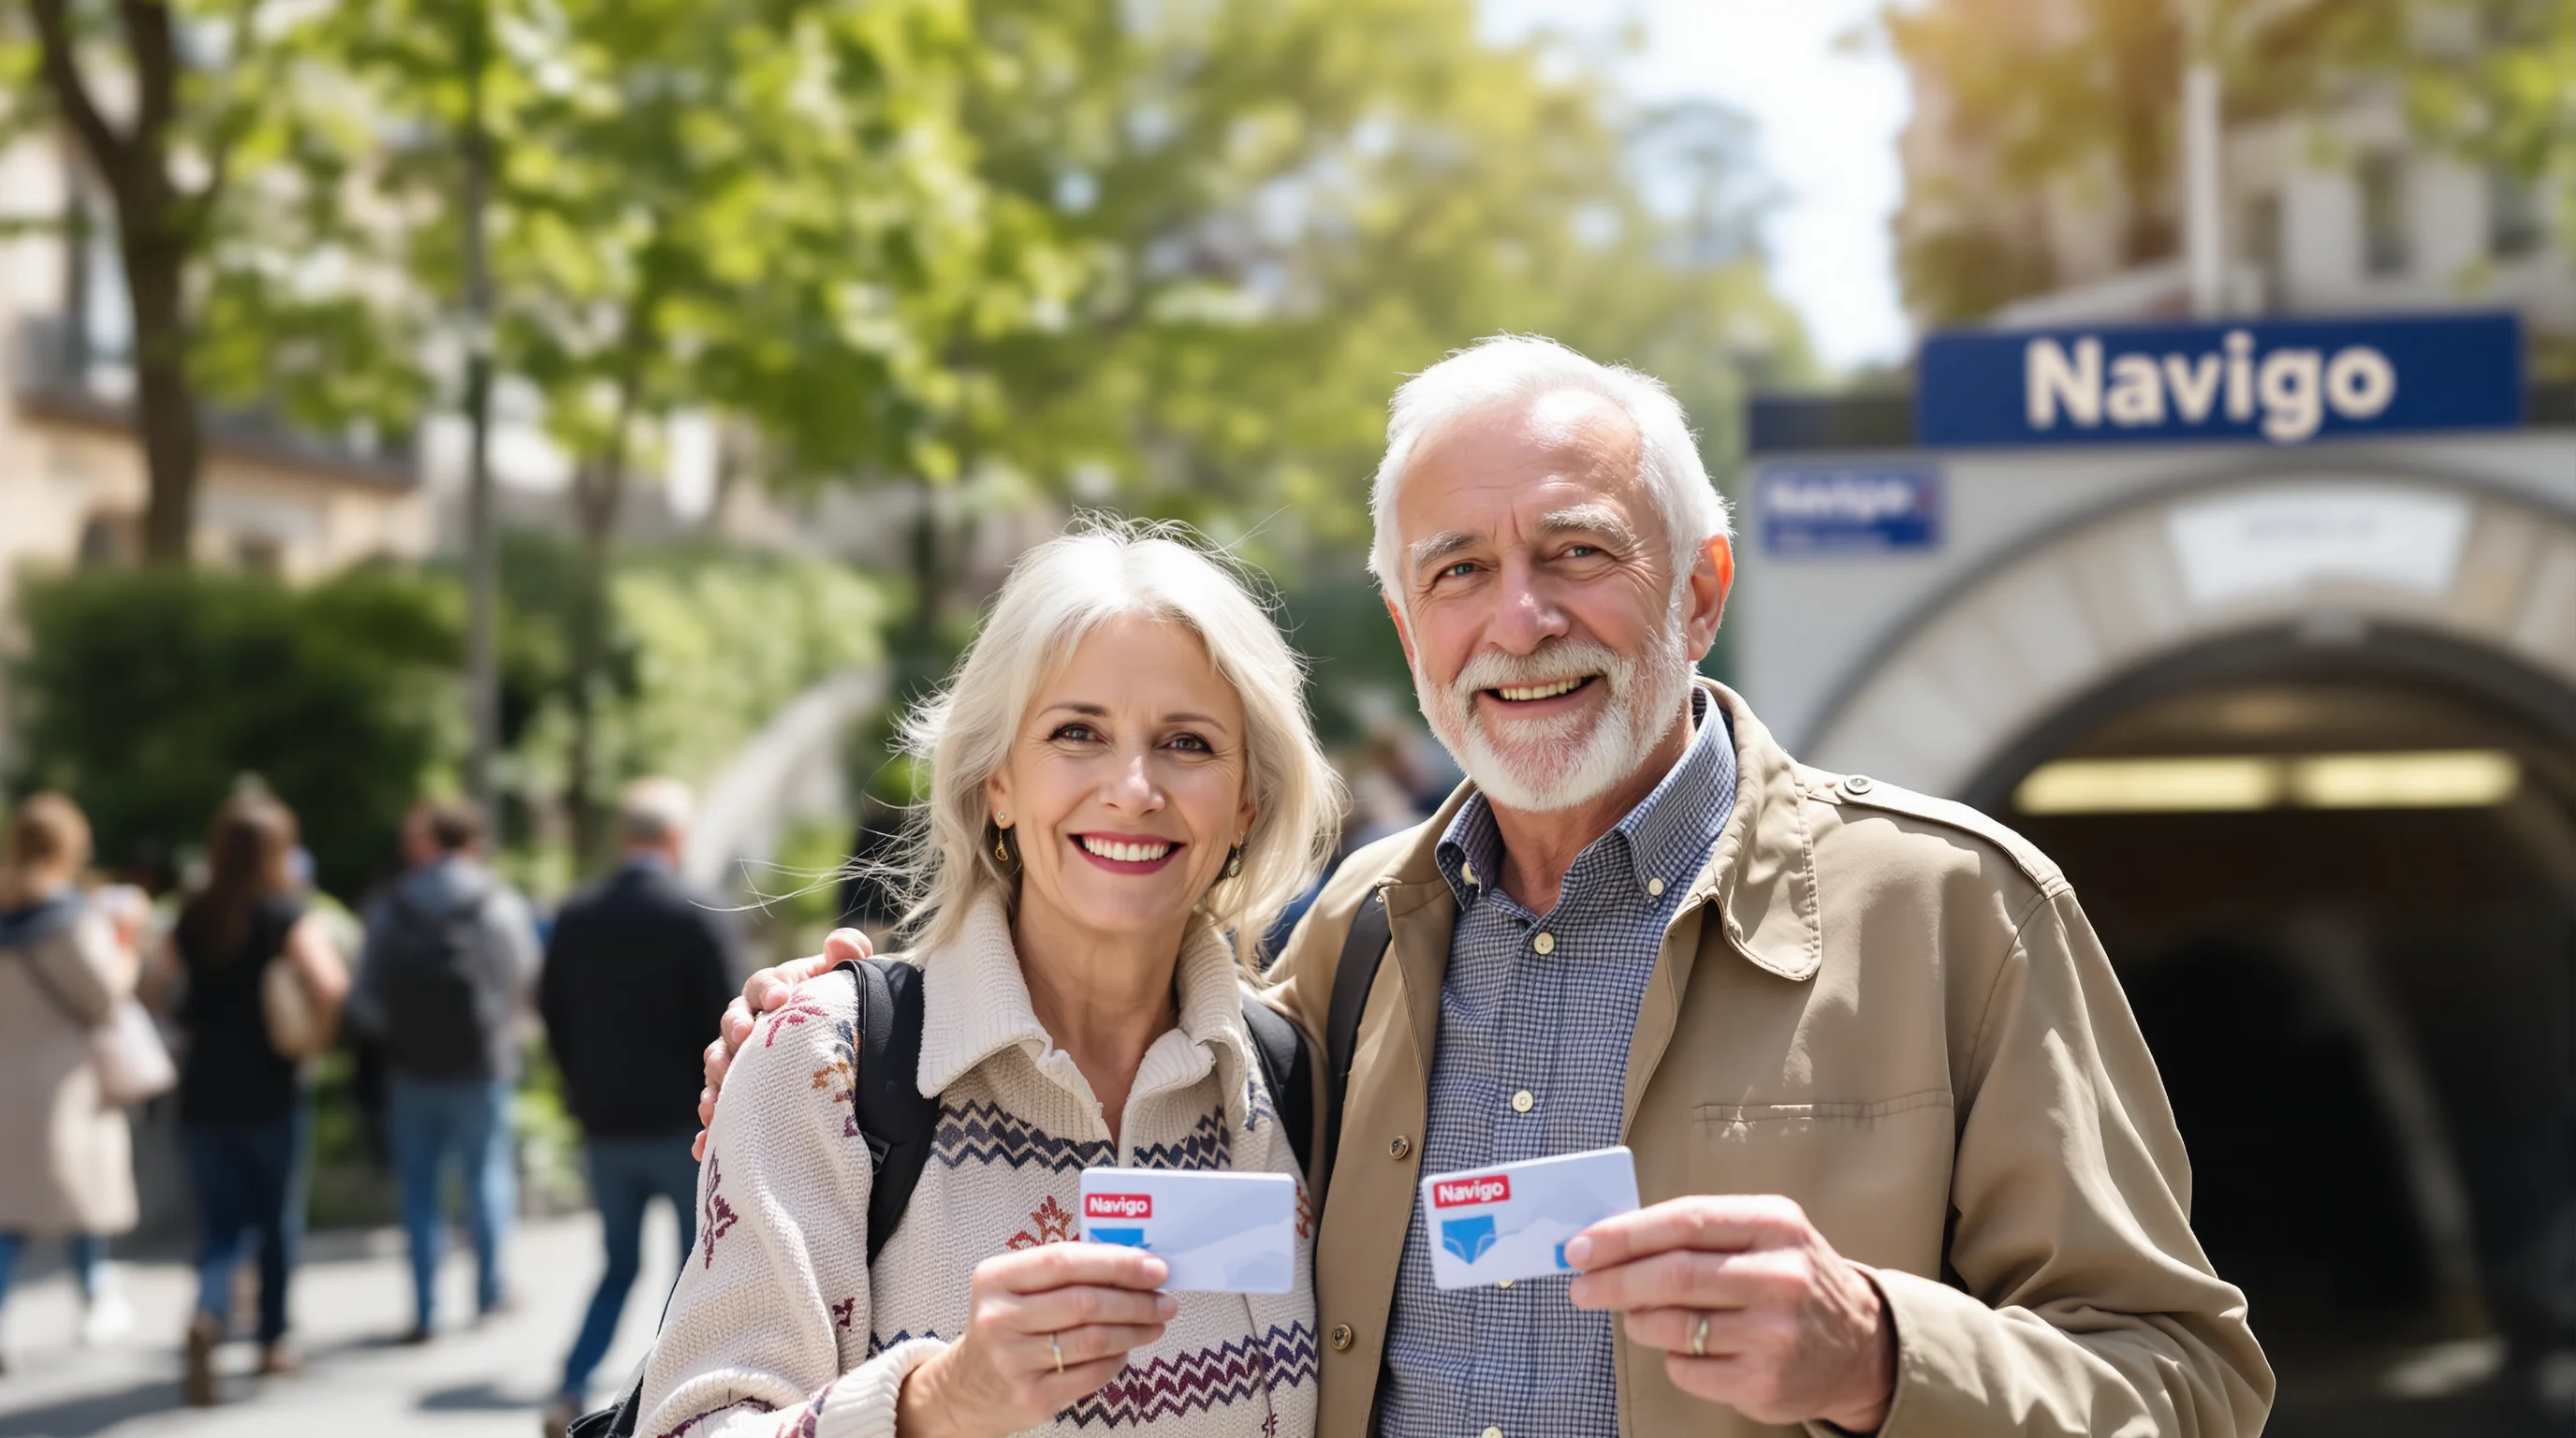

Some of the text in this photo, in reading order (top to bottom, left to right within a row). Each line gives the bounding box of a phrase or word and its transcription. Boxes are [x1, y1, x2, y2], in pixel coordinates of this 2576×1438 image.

[2026, 330, 2396, 443] Navigo
[1439, 1180, 1505, 1203] Navigo
[1090, 1196, 1149, 1216] Navigo
